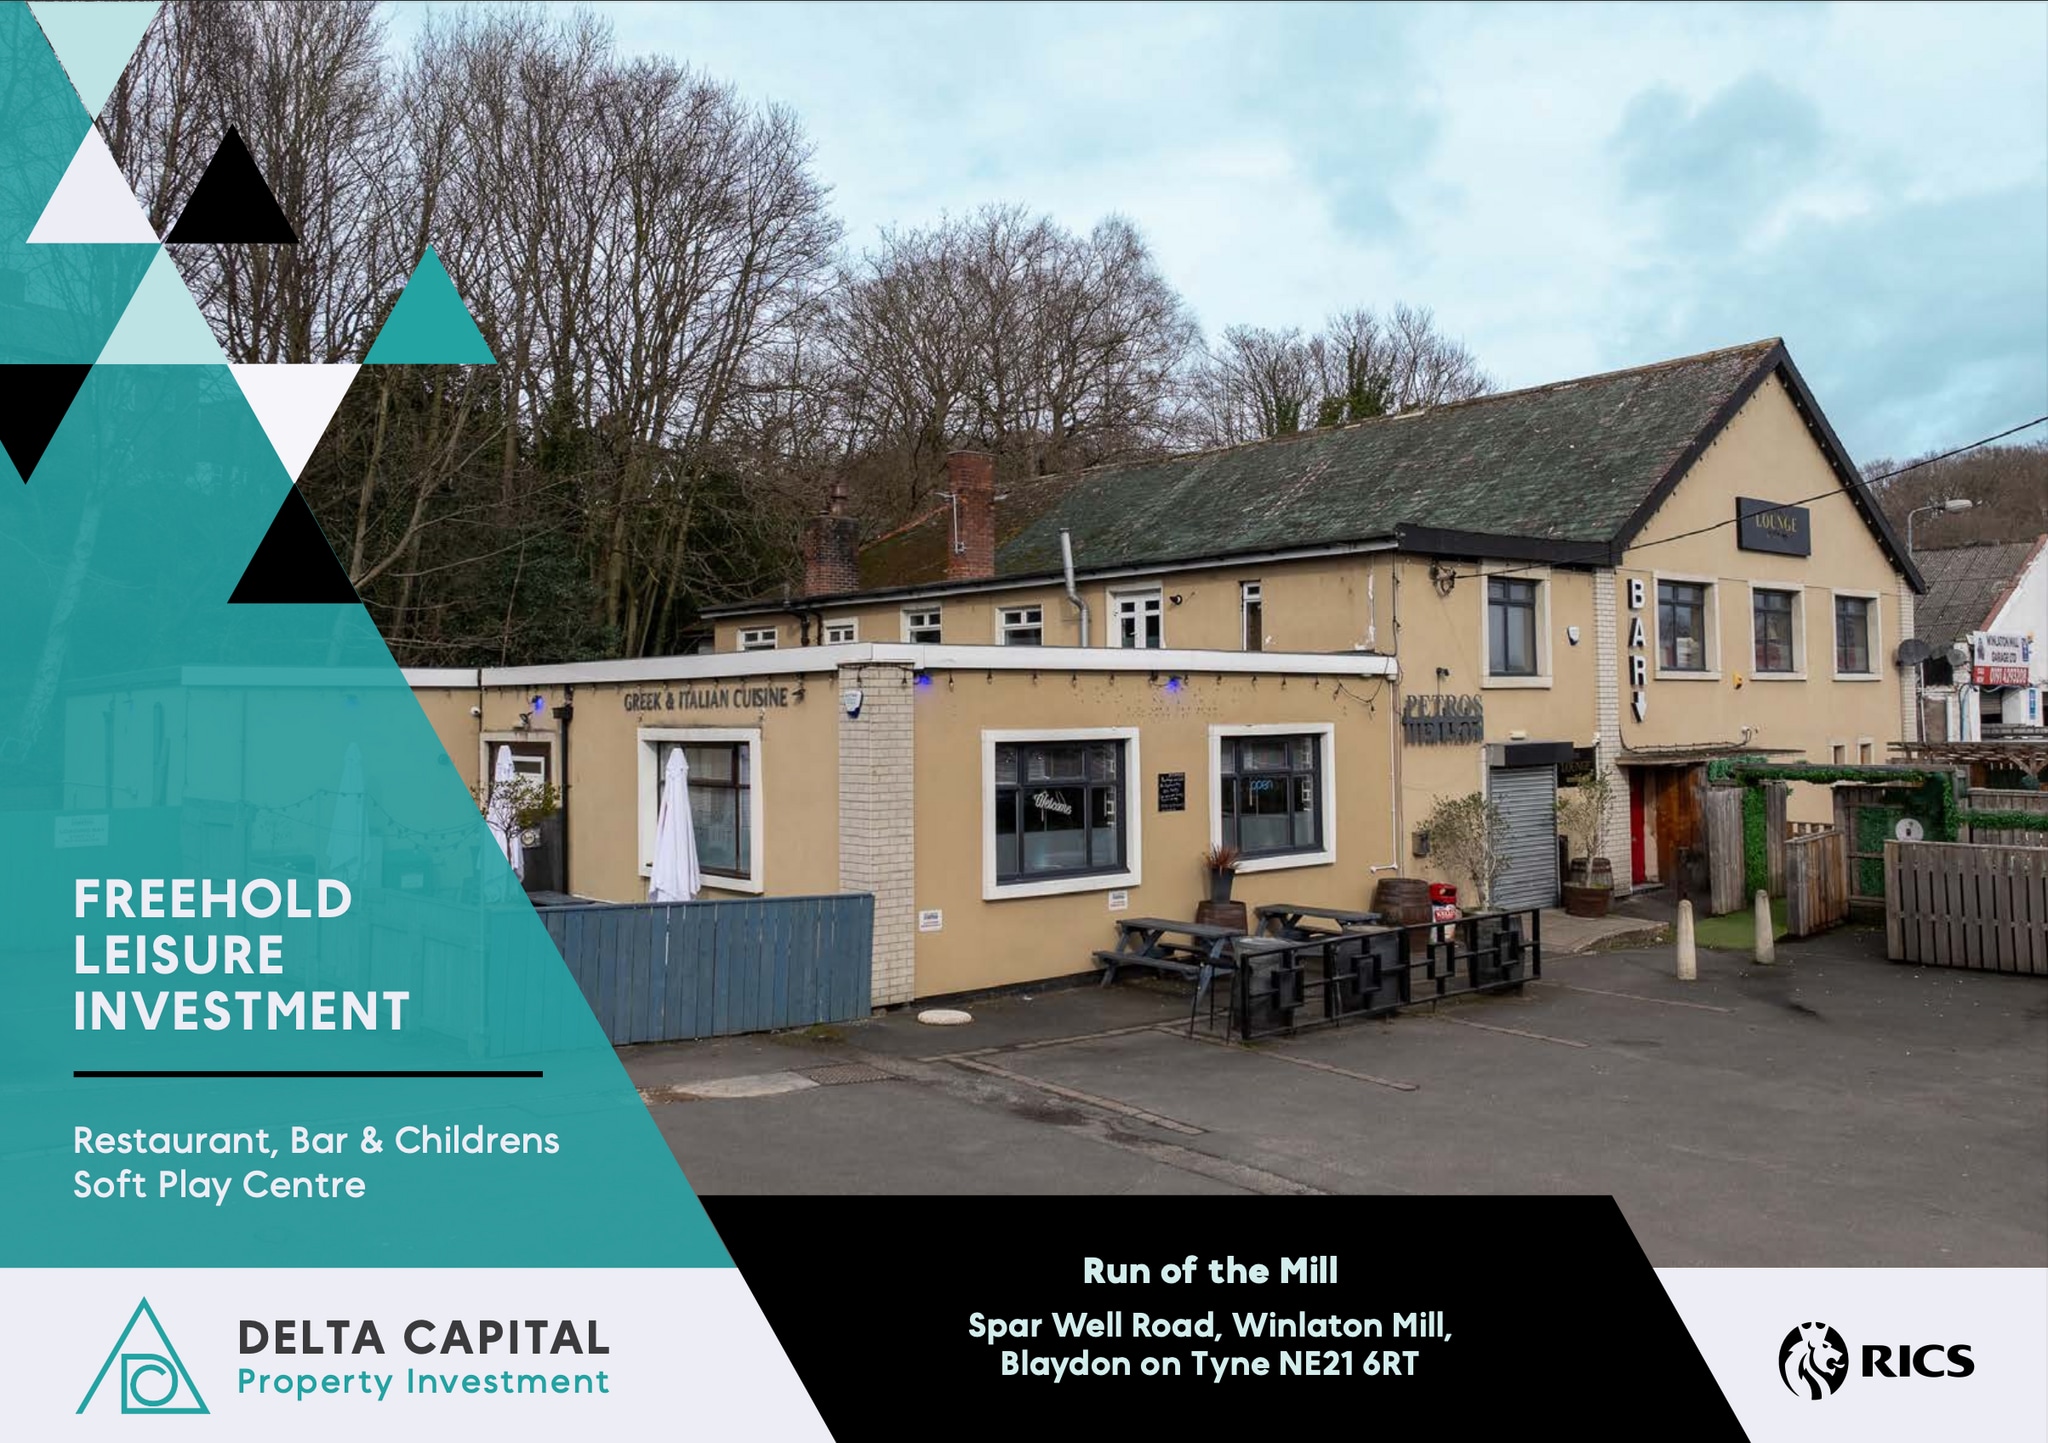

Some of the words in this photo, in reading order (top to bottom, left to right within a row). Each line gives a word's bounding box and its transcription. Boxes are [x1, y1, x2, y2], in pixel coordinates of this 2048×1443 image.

[1755, 514, 1797, 533] LOUNGE
[1627, 578, 1647, 686] BAR
[1992, 651, 2009, 663] GARAGE
[624, 692, 662, 712] GREEK
[665, 692, 675, 711] &
[679, 690, 729, 710] ITALIAN
[733, 687, 789, 708] CUISINE
[1403, 694, 1484, 718] PETROS
[1250, 779, 1274, 793] open
[1033, 790, 1072, 815] Welcome
